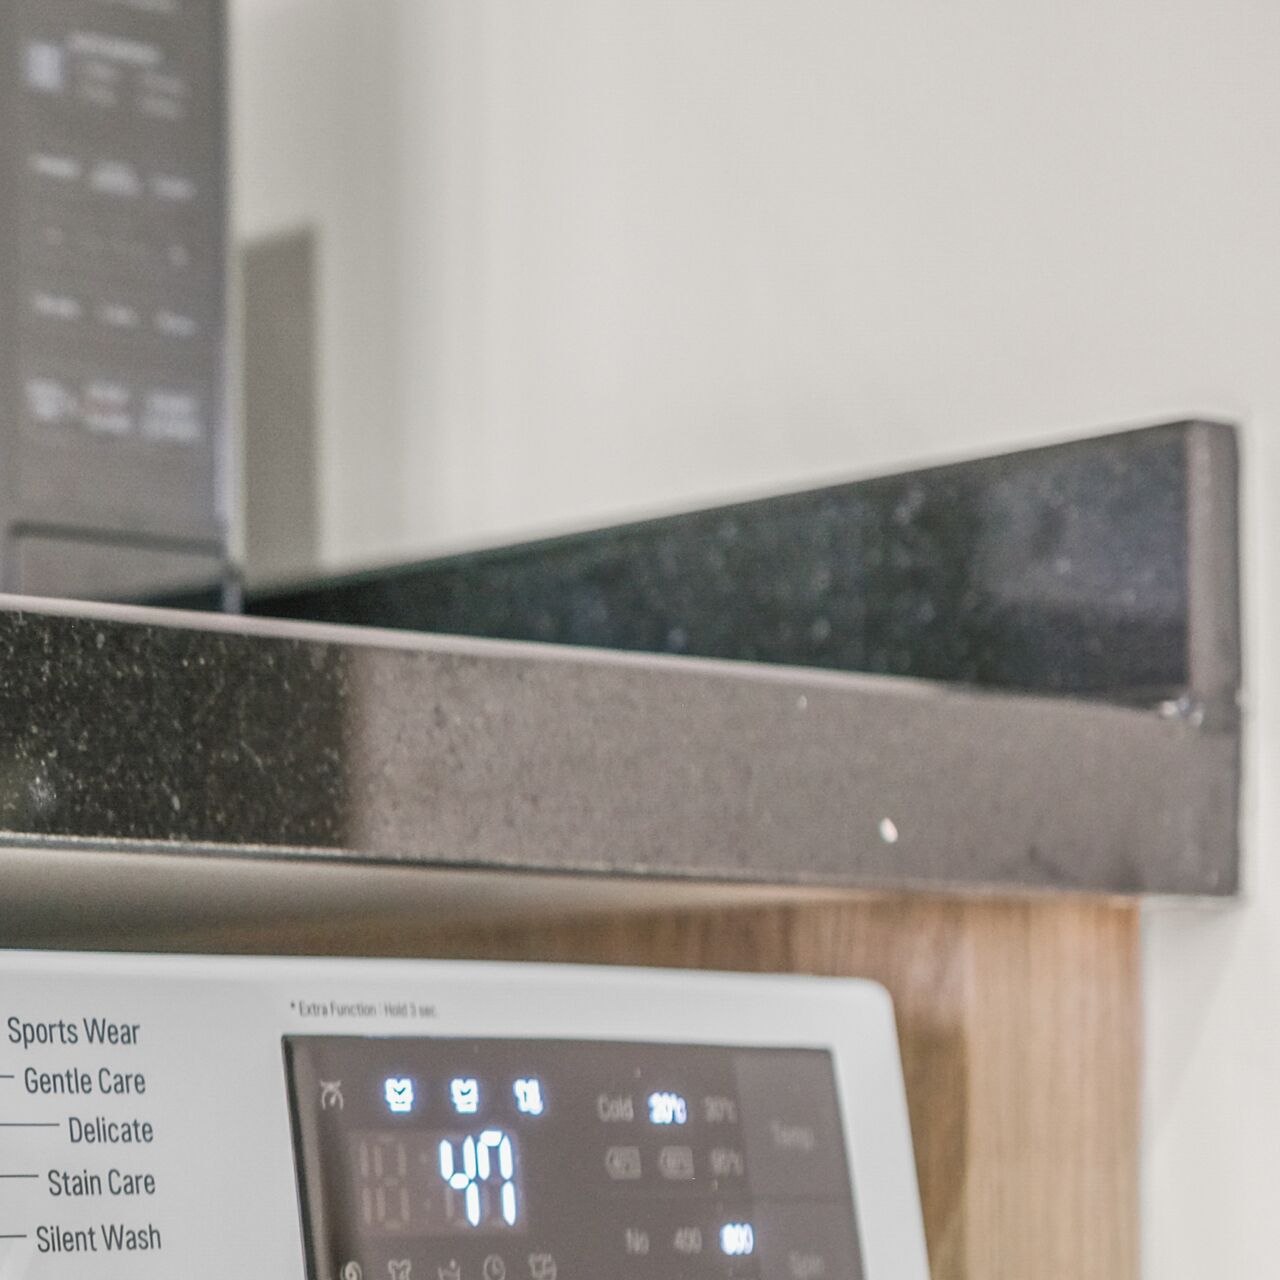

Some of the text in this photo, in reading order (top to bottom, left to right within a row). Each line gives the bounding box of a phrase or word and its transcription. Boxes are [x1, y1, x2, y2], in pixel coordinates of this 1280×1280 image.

[7, 1016, 141, 1049] Sports Wear
[24, 1067, 147, 1095] Gentle Care
[69, 1116, 154, 1144] Delicate
[48, 1169, 156, 1196] Stain Care
[440, 1130, 517, 1227] 47
[36, 1224, 162, 1253] Silent Wash
